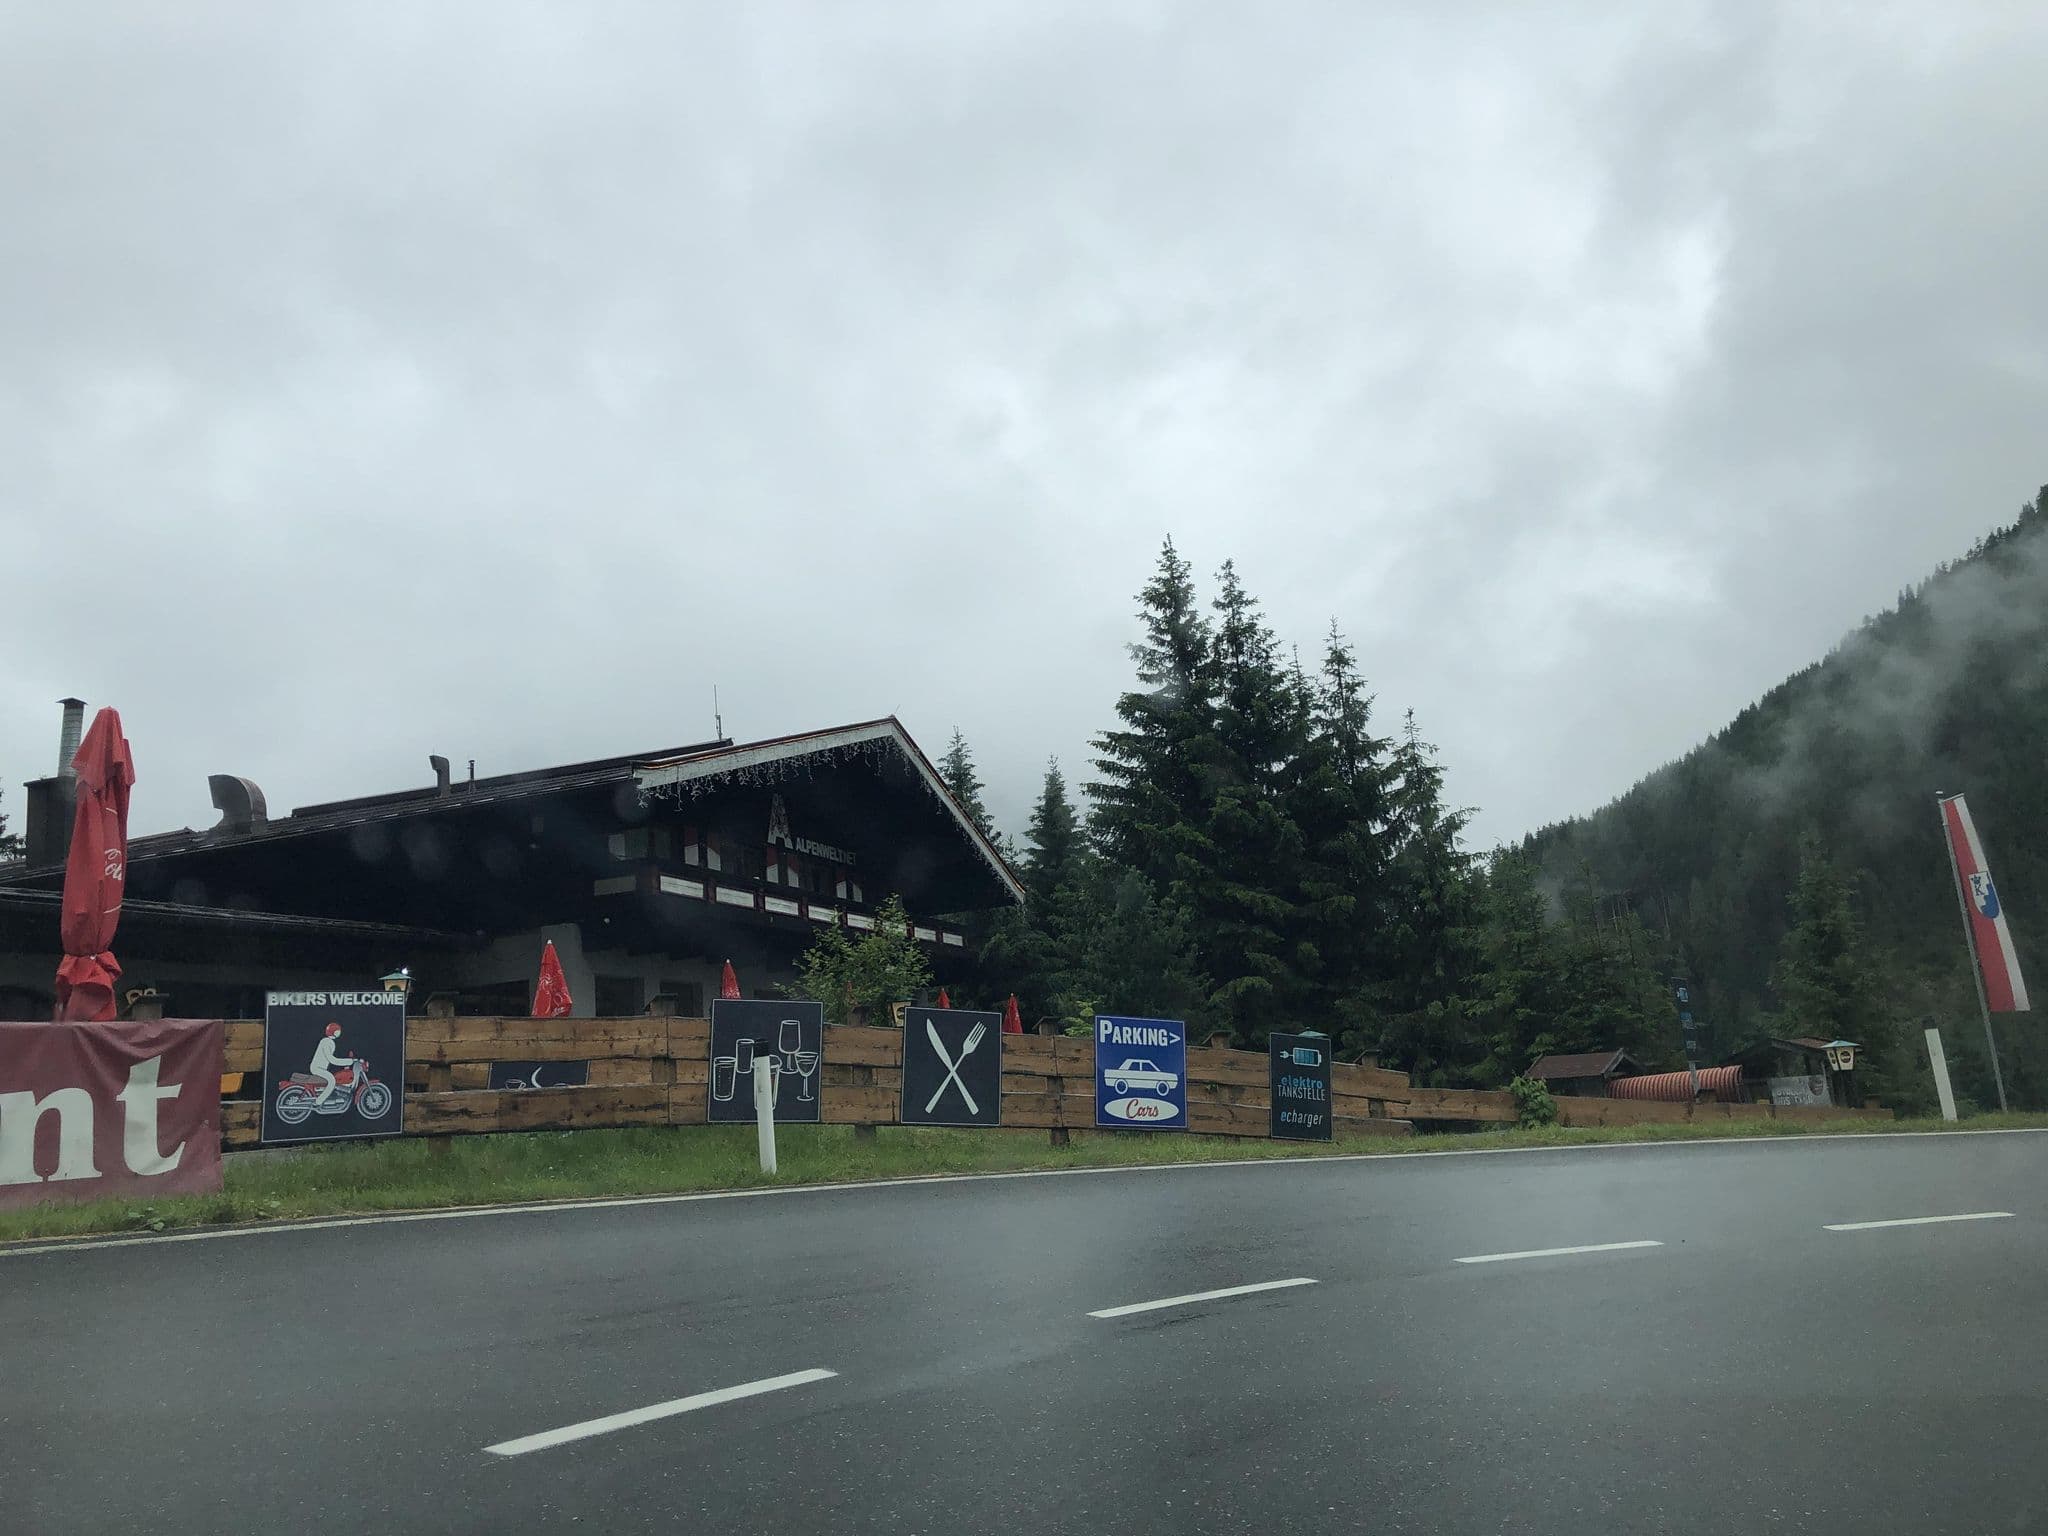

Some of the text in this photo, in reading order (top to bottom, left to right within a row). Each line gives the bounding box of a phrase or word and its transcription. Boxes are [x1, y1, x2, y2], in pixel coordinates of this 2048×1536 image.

[267, 992, 403, 1006] BIKERS WELCOME
[1280, 1075, 1323, 1089] elektro
[1277, 1085, 1326, 1101] TANKSTELLE
[1126, 1099, 1159, 1119] Cars
[1280, 1110, 1323, 1128] echarger
